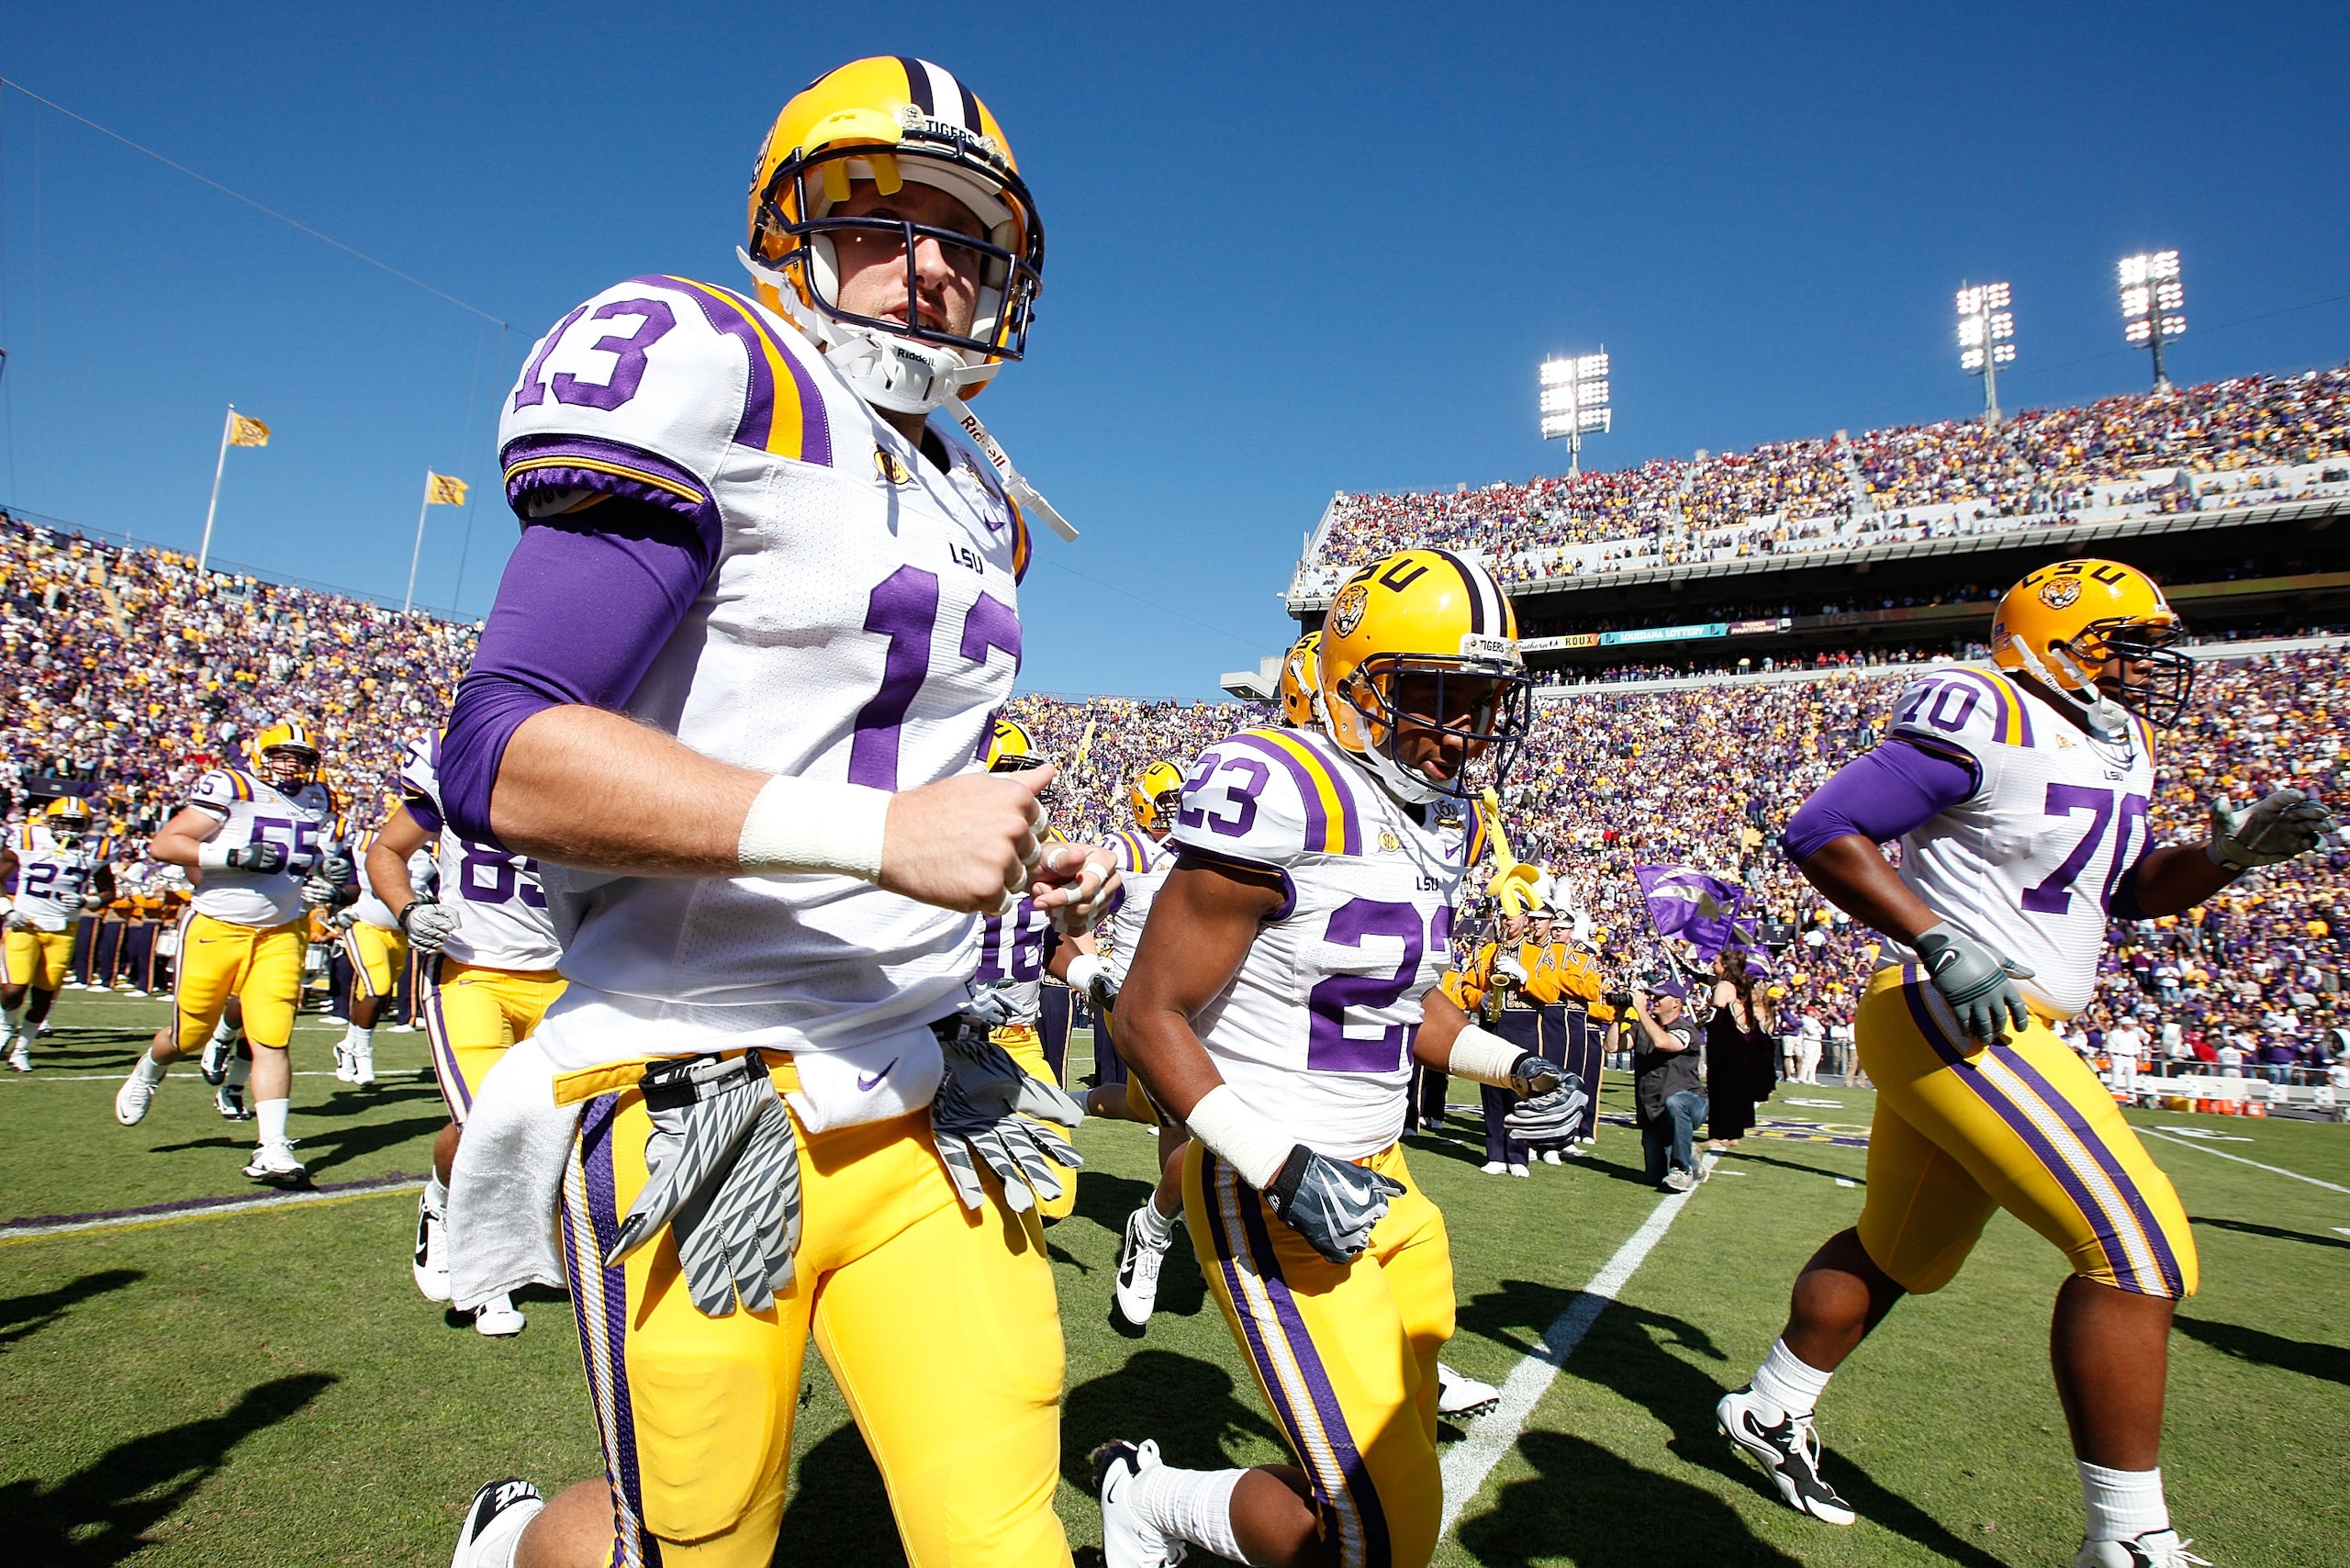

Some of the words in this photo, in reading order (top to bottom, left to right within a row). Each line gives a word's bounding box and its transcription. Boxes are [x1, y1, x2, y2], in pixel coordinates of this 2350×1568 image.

[513, 297, 677, 412] 13
[949, 542, 983, 576] LSU
[2022, 561, 2127, 589] LSU
[1480, 640, 1505, 654] TIGERS
[1565, 636, 1594, 646] ROUX
[1902, 678, 1981, 733] 70
[1178, 753, 1270, 838] 23
[1416, 876, 1438, 892] LSU
